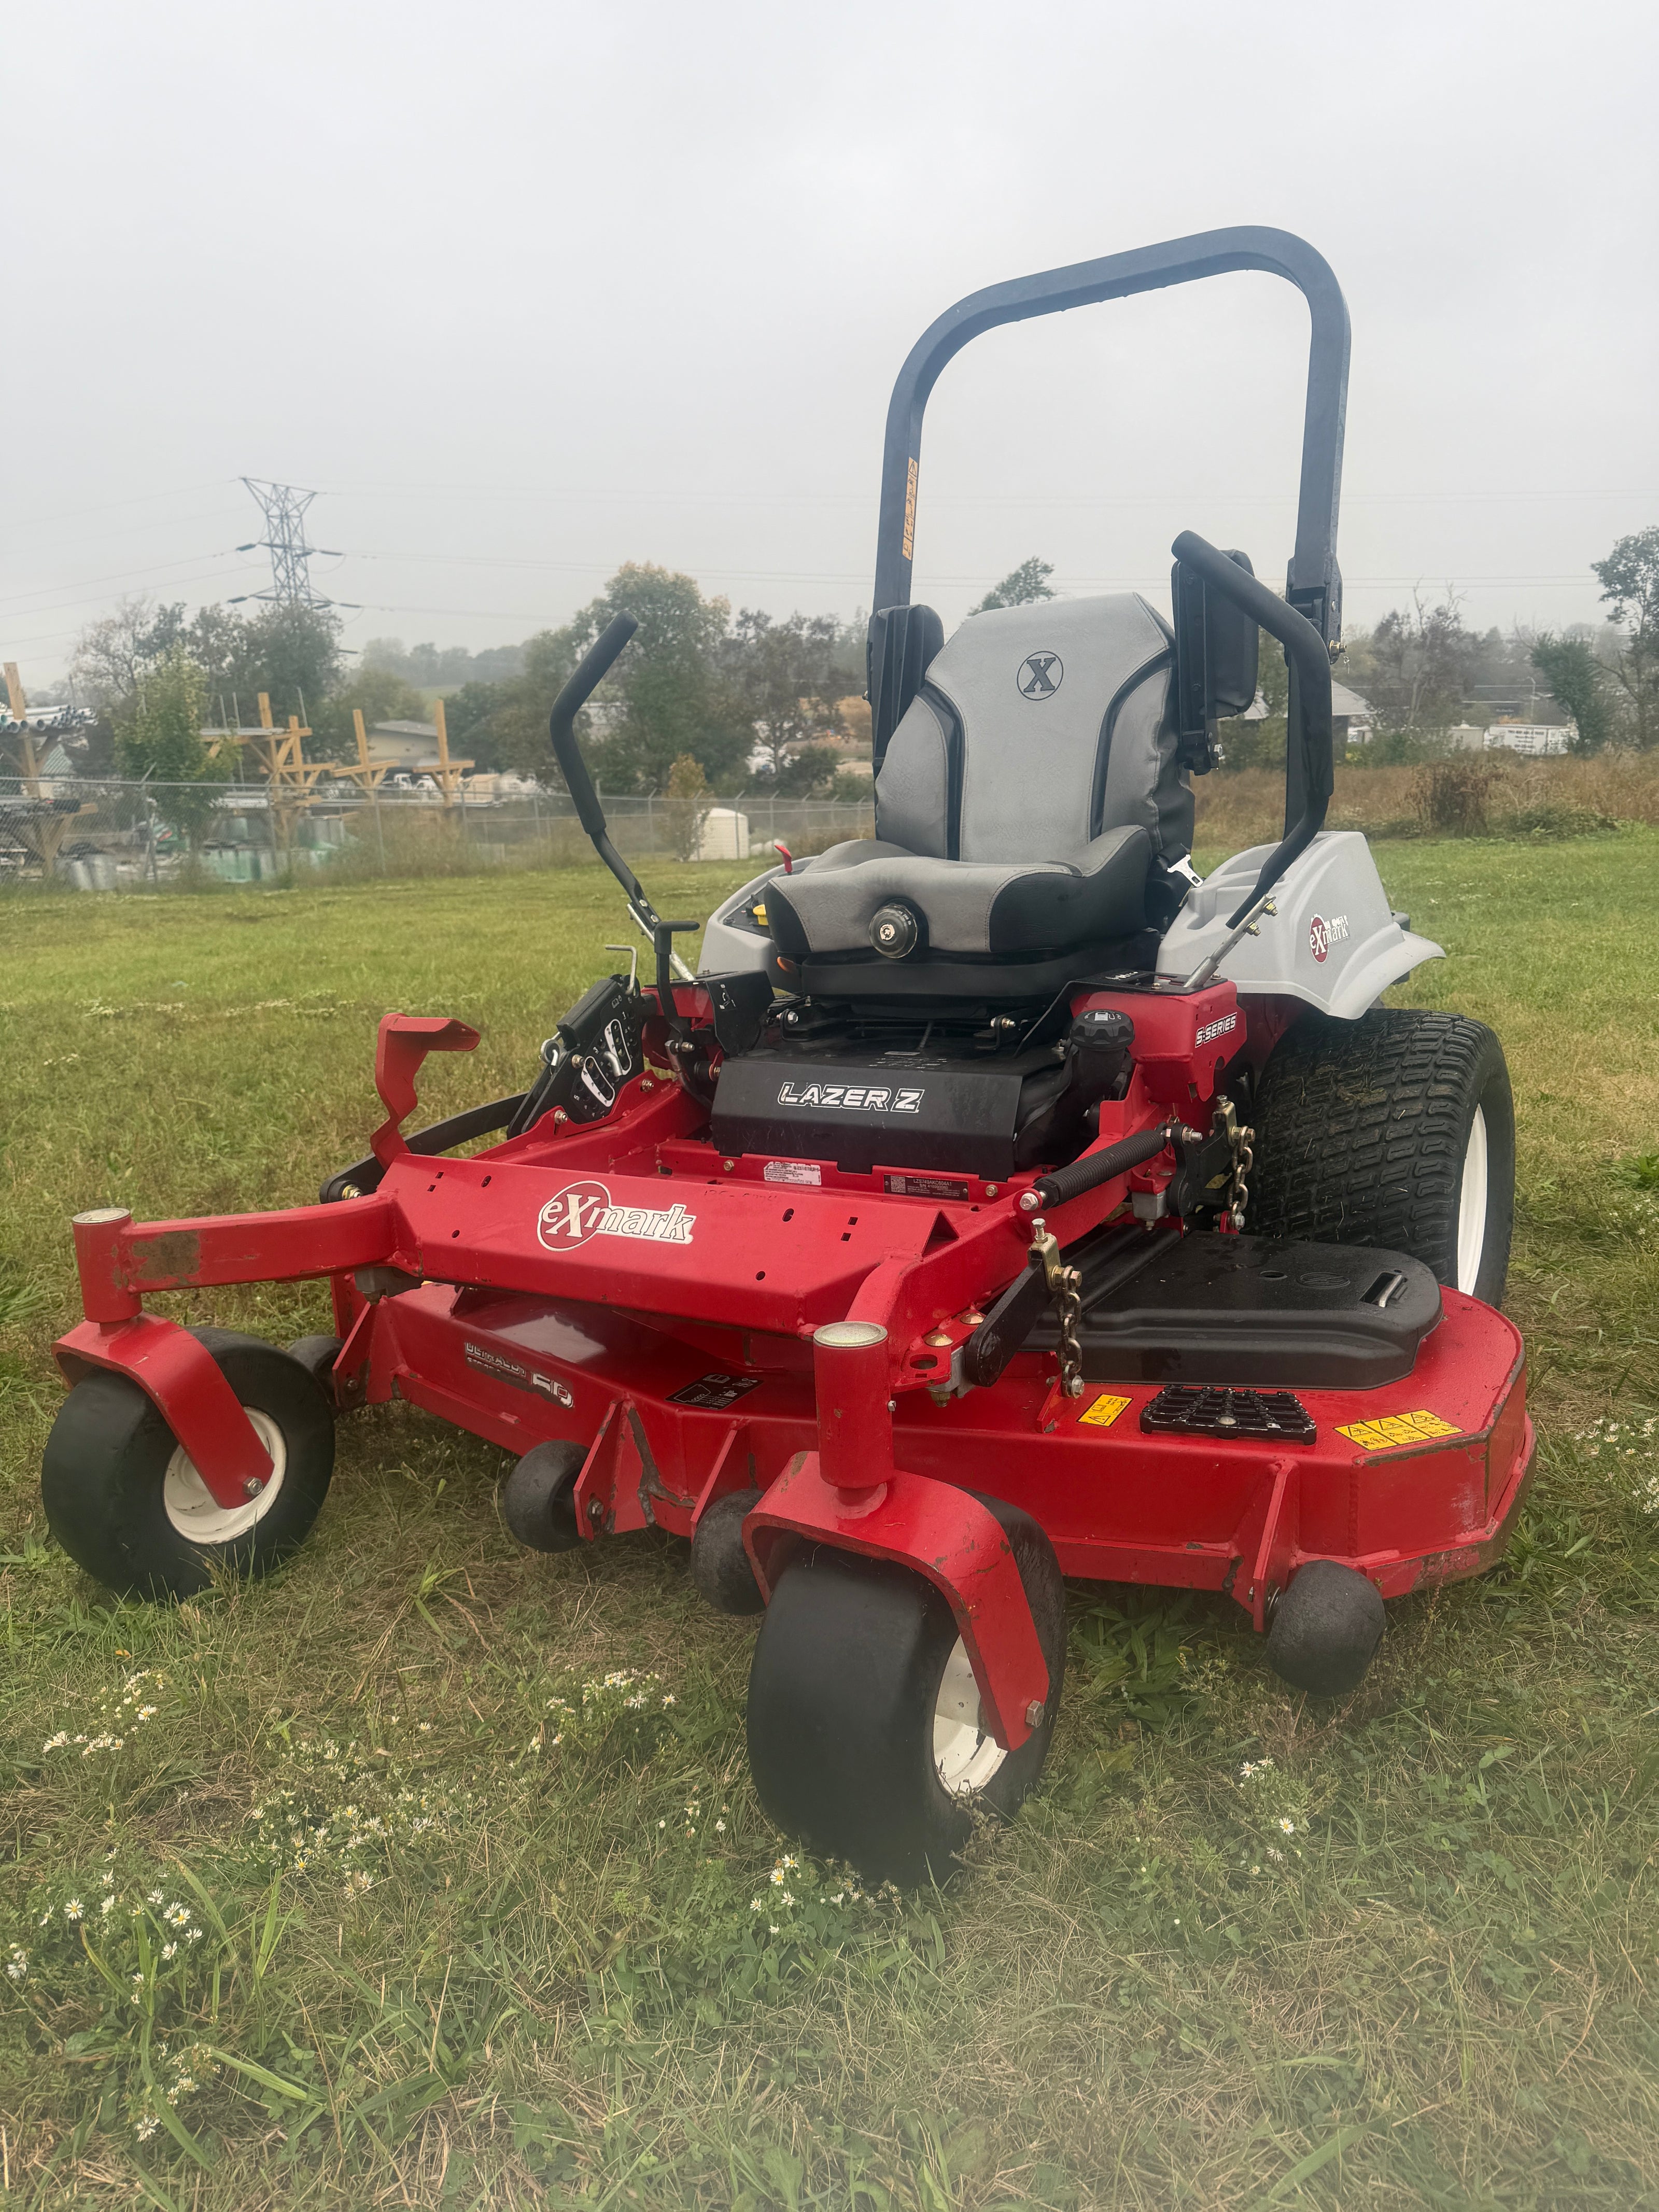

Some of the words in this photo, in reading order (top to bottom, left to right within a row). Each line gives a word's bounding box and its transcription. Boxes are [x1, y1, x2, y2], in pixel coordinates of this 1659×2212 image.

[1023, 657, 1056, 693] X
[1310, 918, 1348, 956] eXmark
[1195, 1013, 1236, 1046] S-SERIES
[780, 1083, 885, 1110] LAZER
[892, 1090, 922, 1111] Z
[542, 1193, 695, 1241] eXmark
